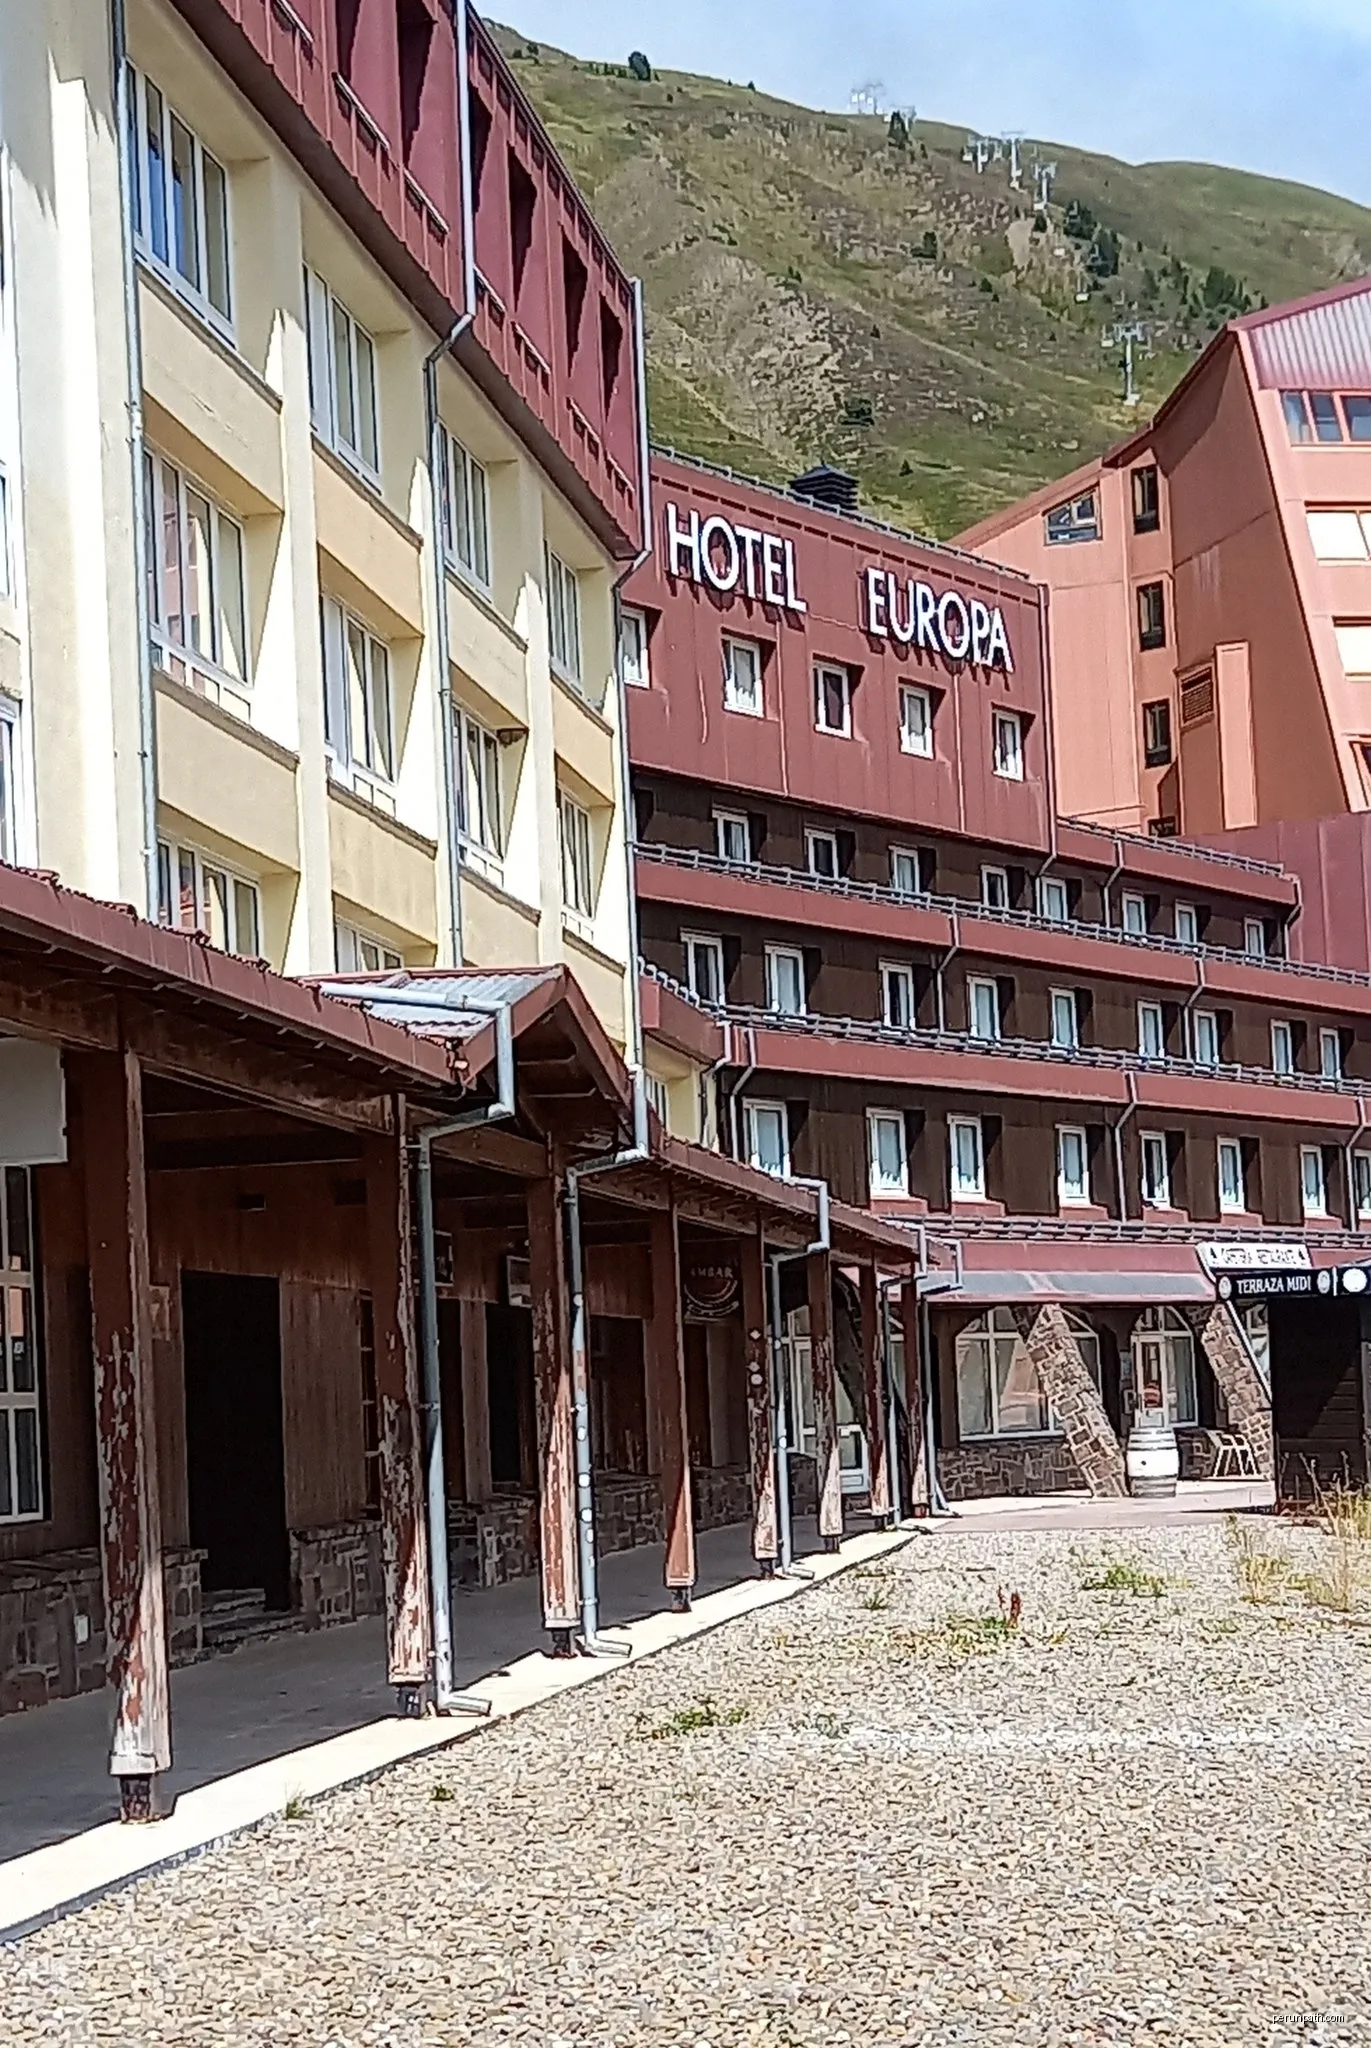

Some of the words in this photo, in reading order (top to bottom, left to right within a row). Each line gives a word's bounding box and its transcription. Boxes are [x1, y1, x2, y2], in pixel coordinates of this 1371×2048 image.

[666, 502, 807, 613] HOTEL
[866, 566, 1014, 673] EUROPA
[1236, 1277, 1284, 1294] TERRAZA
